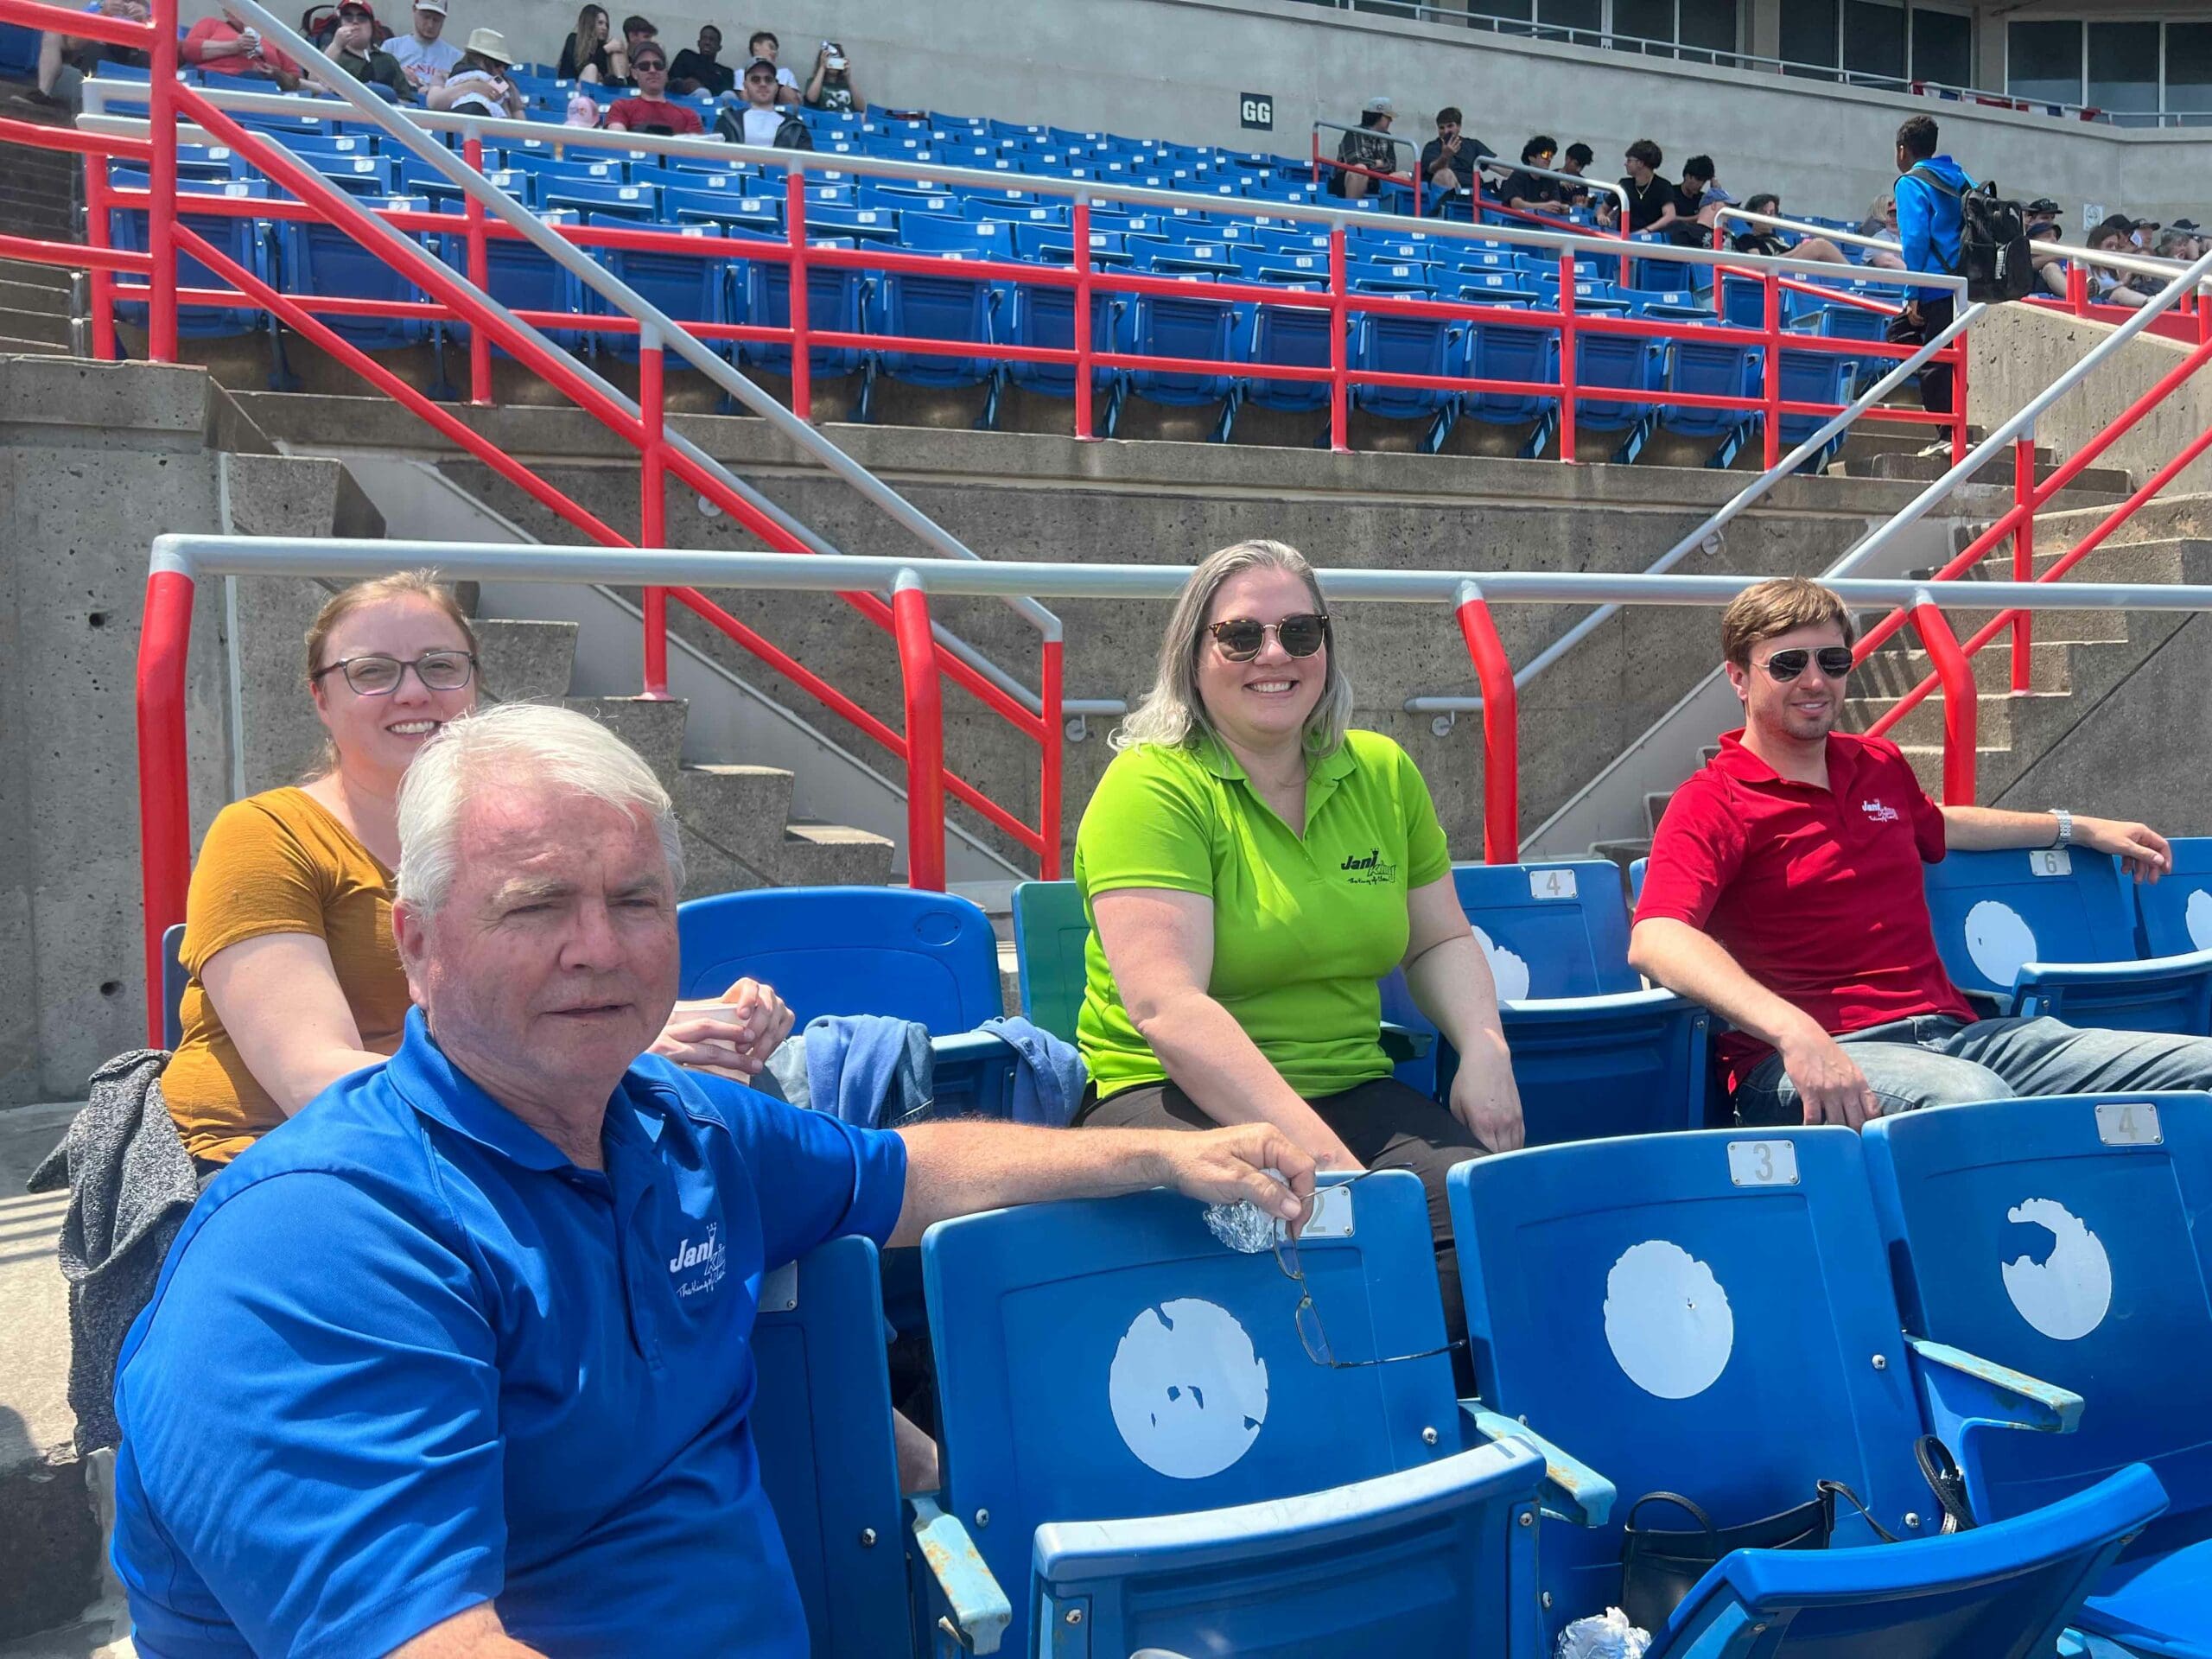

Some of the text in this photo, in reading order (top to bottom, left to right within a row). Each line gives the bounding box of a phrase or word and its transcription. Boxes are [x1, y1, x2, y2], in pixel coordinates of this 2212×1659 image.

[1243, 100, 1271, 124] GG
[1341, 849, 1379, 870] Jani
[2044, 852, 2056, 874] 6
[1546, 871, 1560, 896] 4
[2118, 1107, 2139, 1141] 4
[1752, 1142, 1773, 1182] 3
[1306, 1193, 1327, 1233] 2
[670, 1224, 716, 1273] Jani
